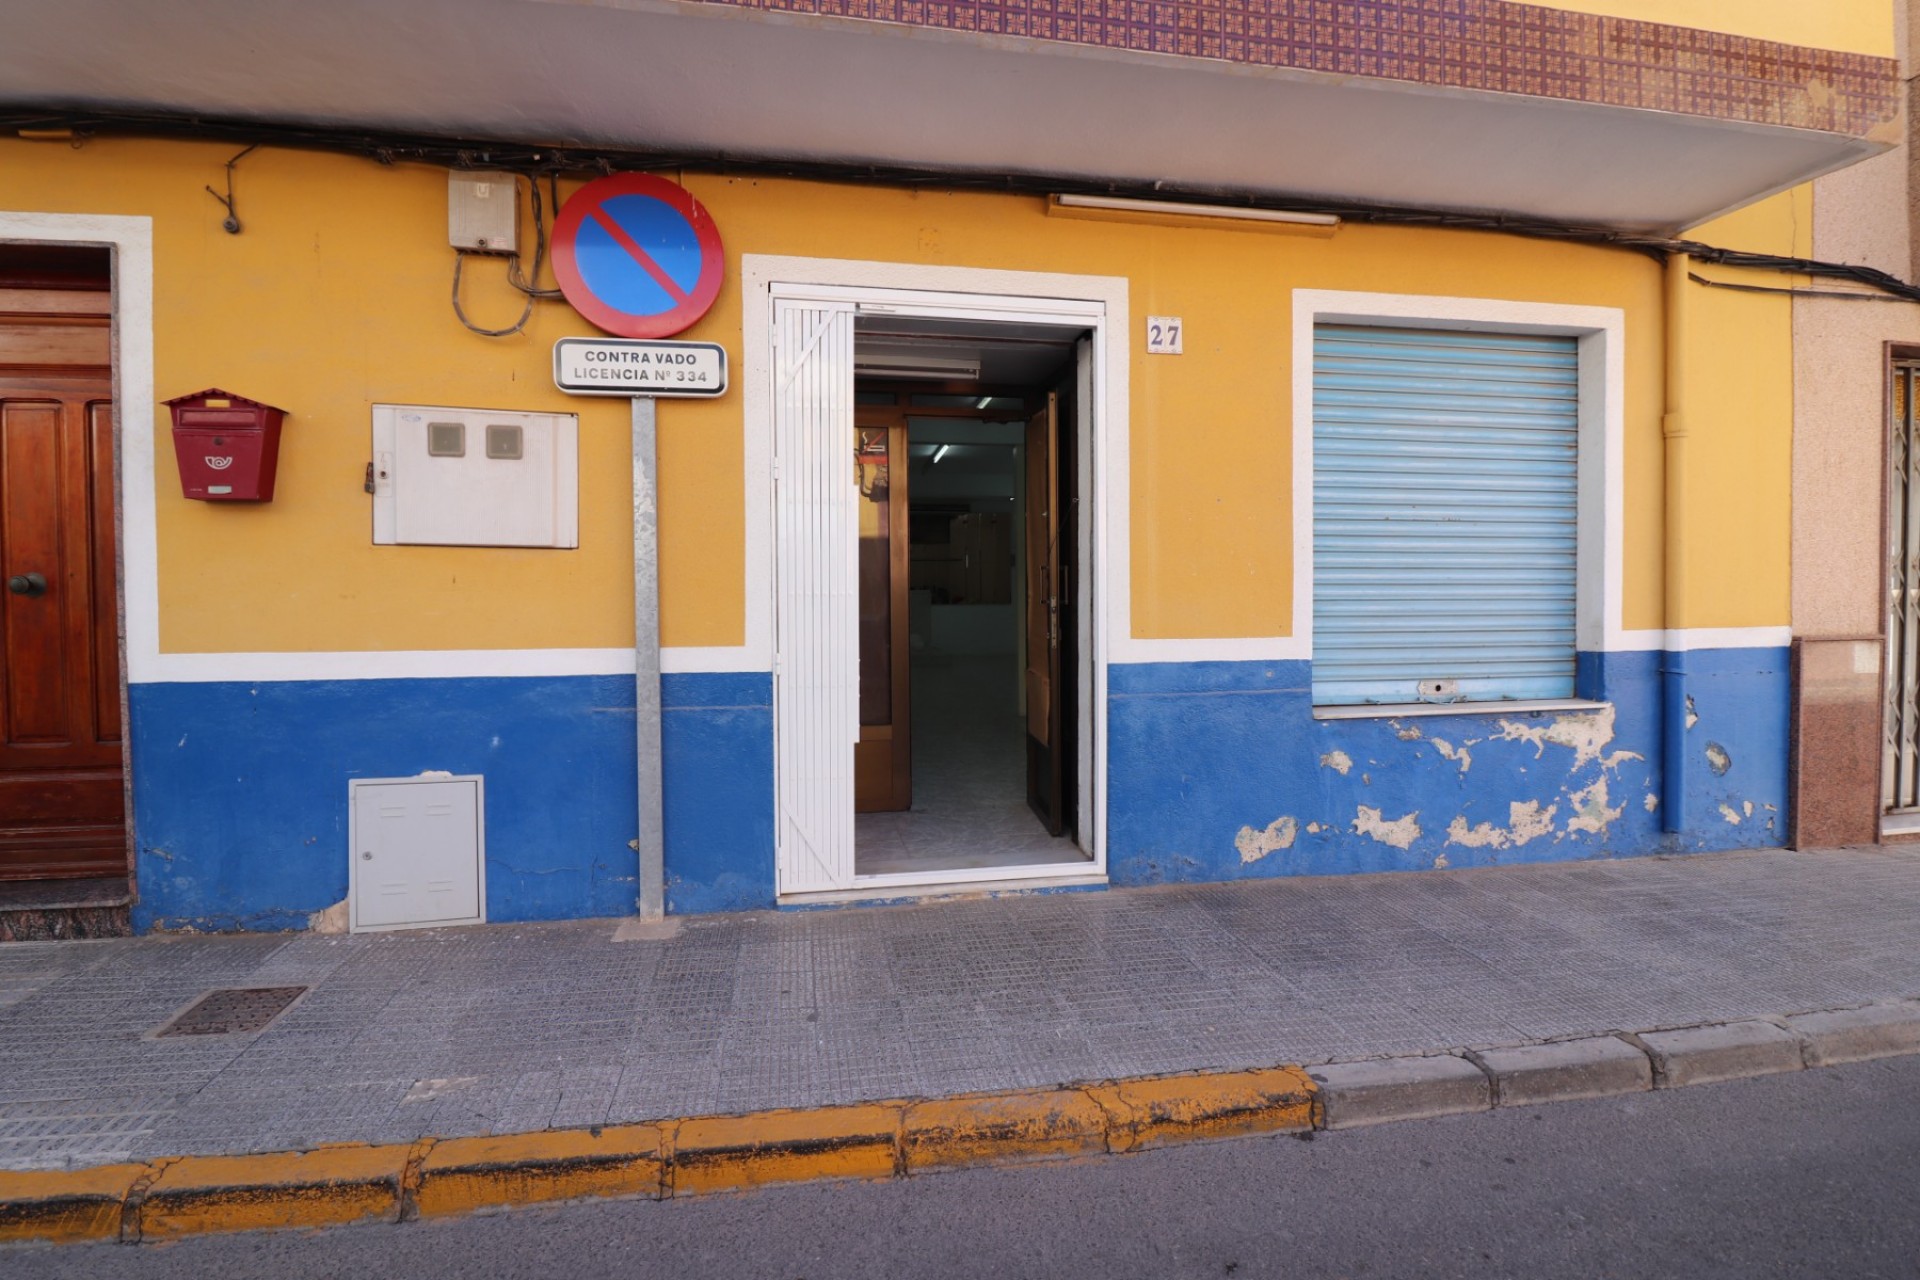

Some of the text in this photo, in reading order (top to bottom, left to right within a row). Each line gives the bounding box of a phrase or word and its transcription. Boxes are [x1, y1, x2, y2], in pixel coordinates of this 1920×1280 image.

[1150, 324, 1179, 346] 27
[585, 351, 697, 365] CONTRA VADO
[574, 367, 649, 380] LICENCIA
[676, 371, 707, 382] 334
